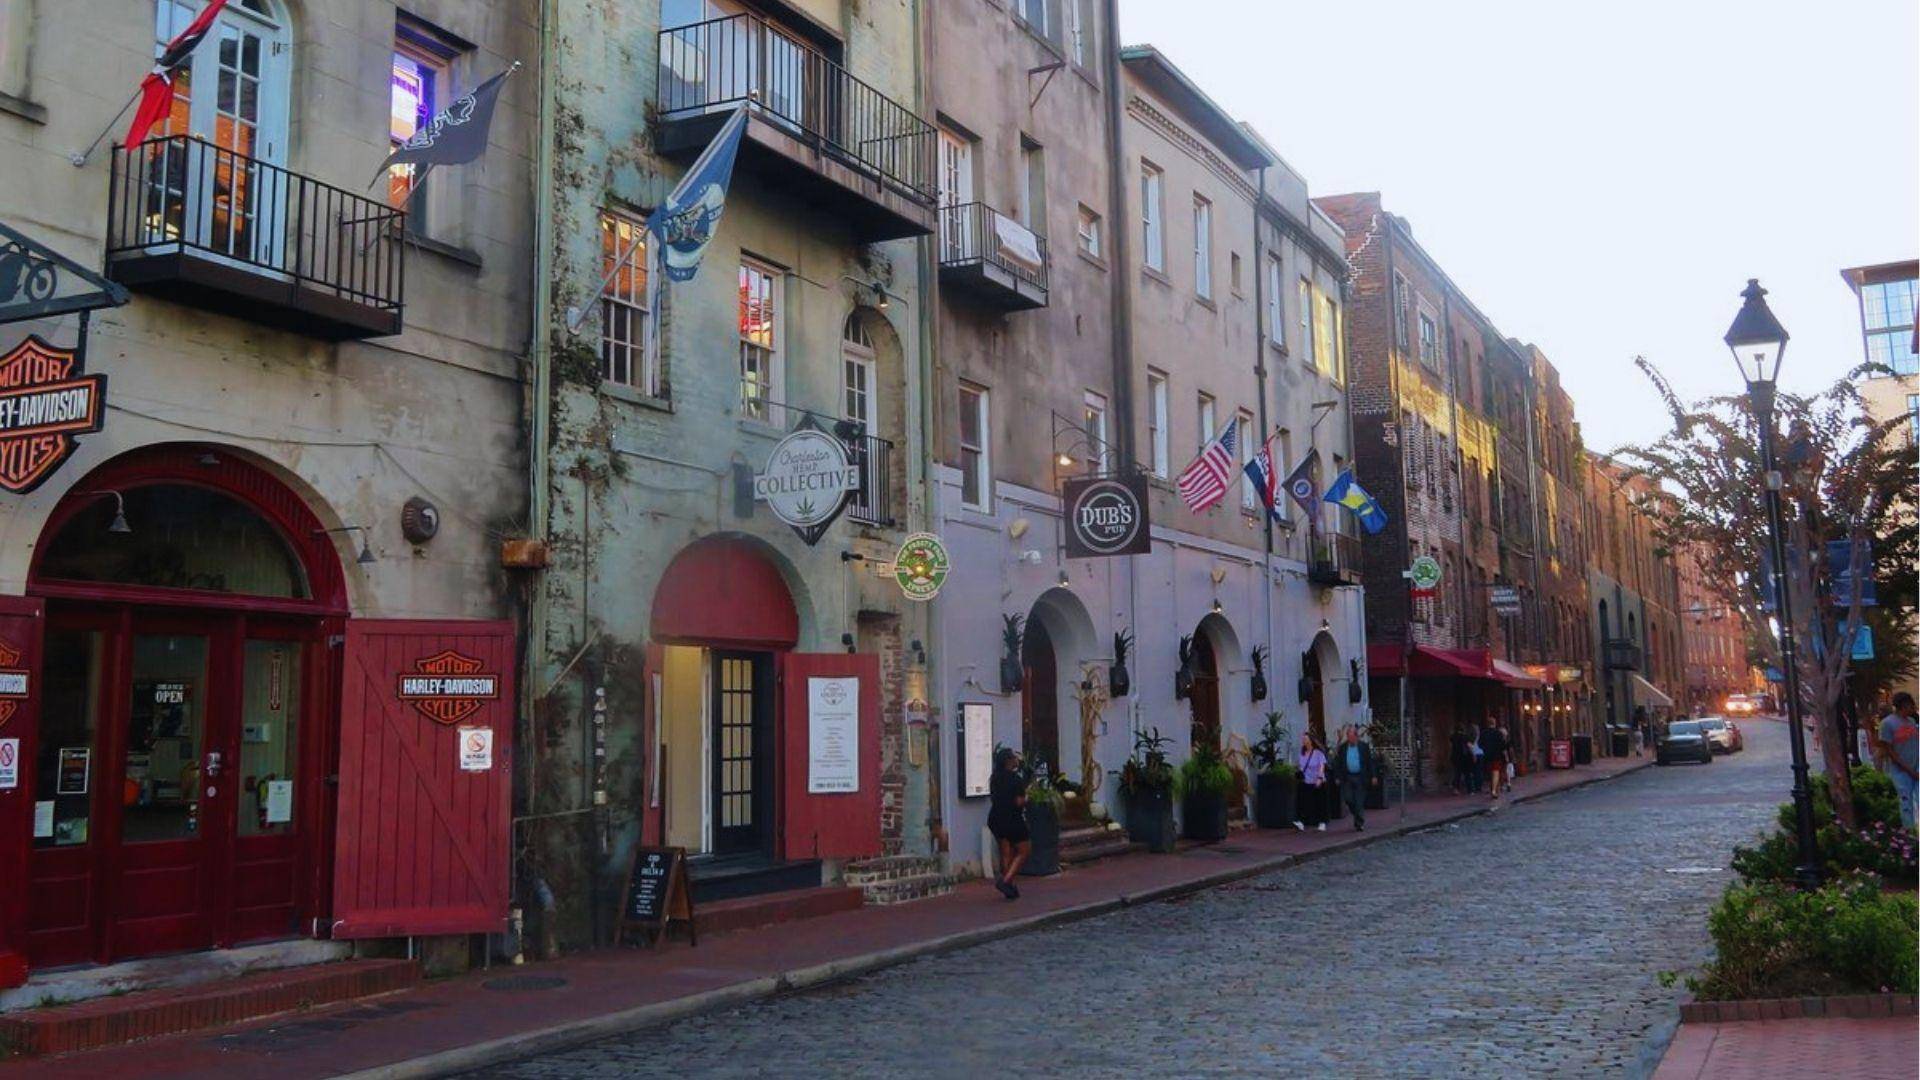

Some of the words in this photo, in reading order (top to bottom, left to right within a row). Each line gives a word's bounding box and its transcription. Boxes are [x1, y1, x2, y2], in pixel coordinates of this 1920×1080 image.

[756, 468, 856, 496] COLLECTIVE
[1080, 503, 1132, 527] DUB'S
[425, 656, 473, 674] MOTOR
[403, 678, 494, 695] HARLEY-DAVIDSON
[155, 690, 184, 703] OPEN
[424, 700, 472, 720] CYCLES
